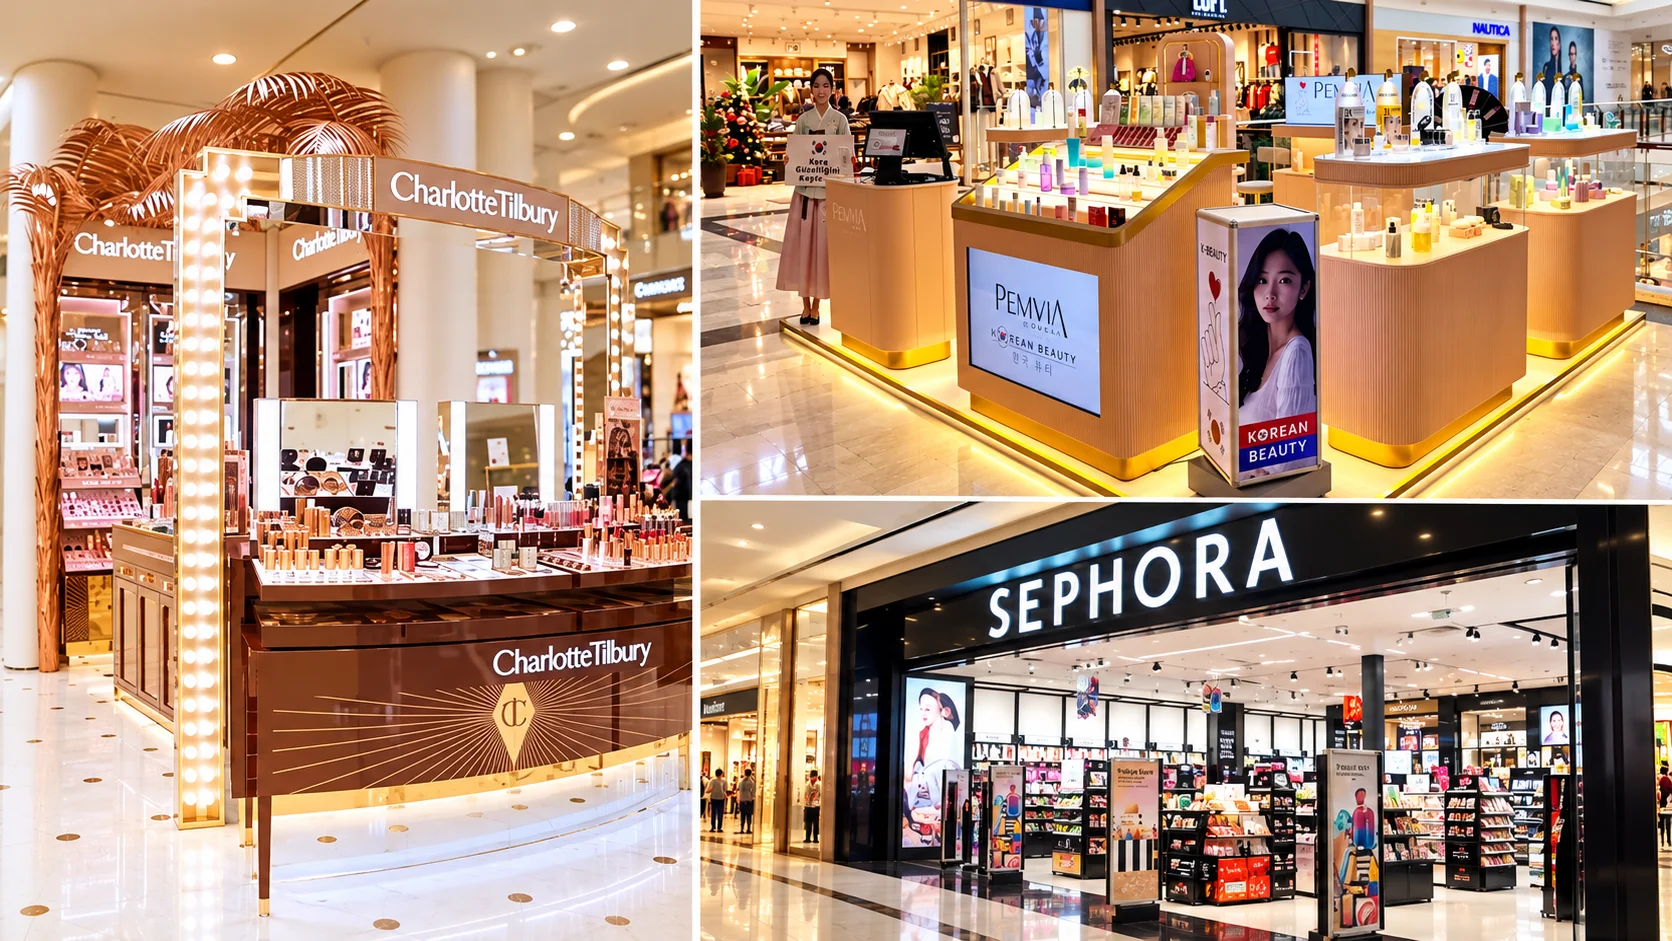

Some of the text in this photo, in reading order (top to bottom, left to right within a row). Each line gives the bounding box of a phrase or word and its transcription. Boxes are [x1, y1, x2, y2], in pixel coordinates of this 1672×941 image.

[1473, 22, 1510, 36] NAUTICA
[1200, 242, 1228, 264] K-BEAUTY
[995, 283, 1068, 339] PEMVIA
[990, 326, 1077, 364] KOREAN BEAUTY
[1248, 420, 1309, 444] KOREAN
[1249, 439, 1308, 464] BEAUTY
[988, 517, 1294, 639] SEPHORA
